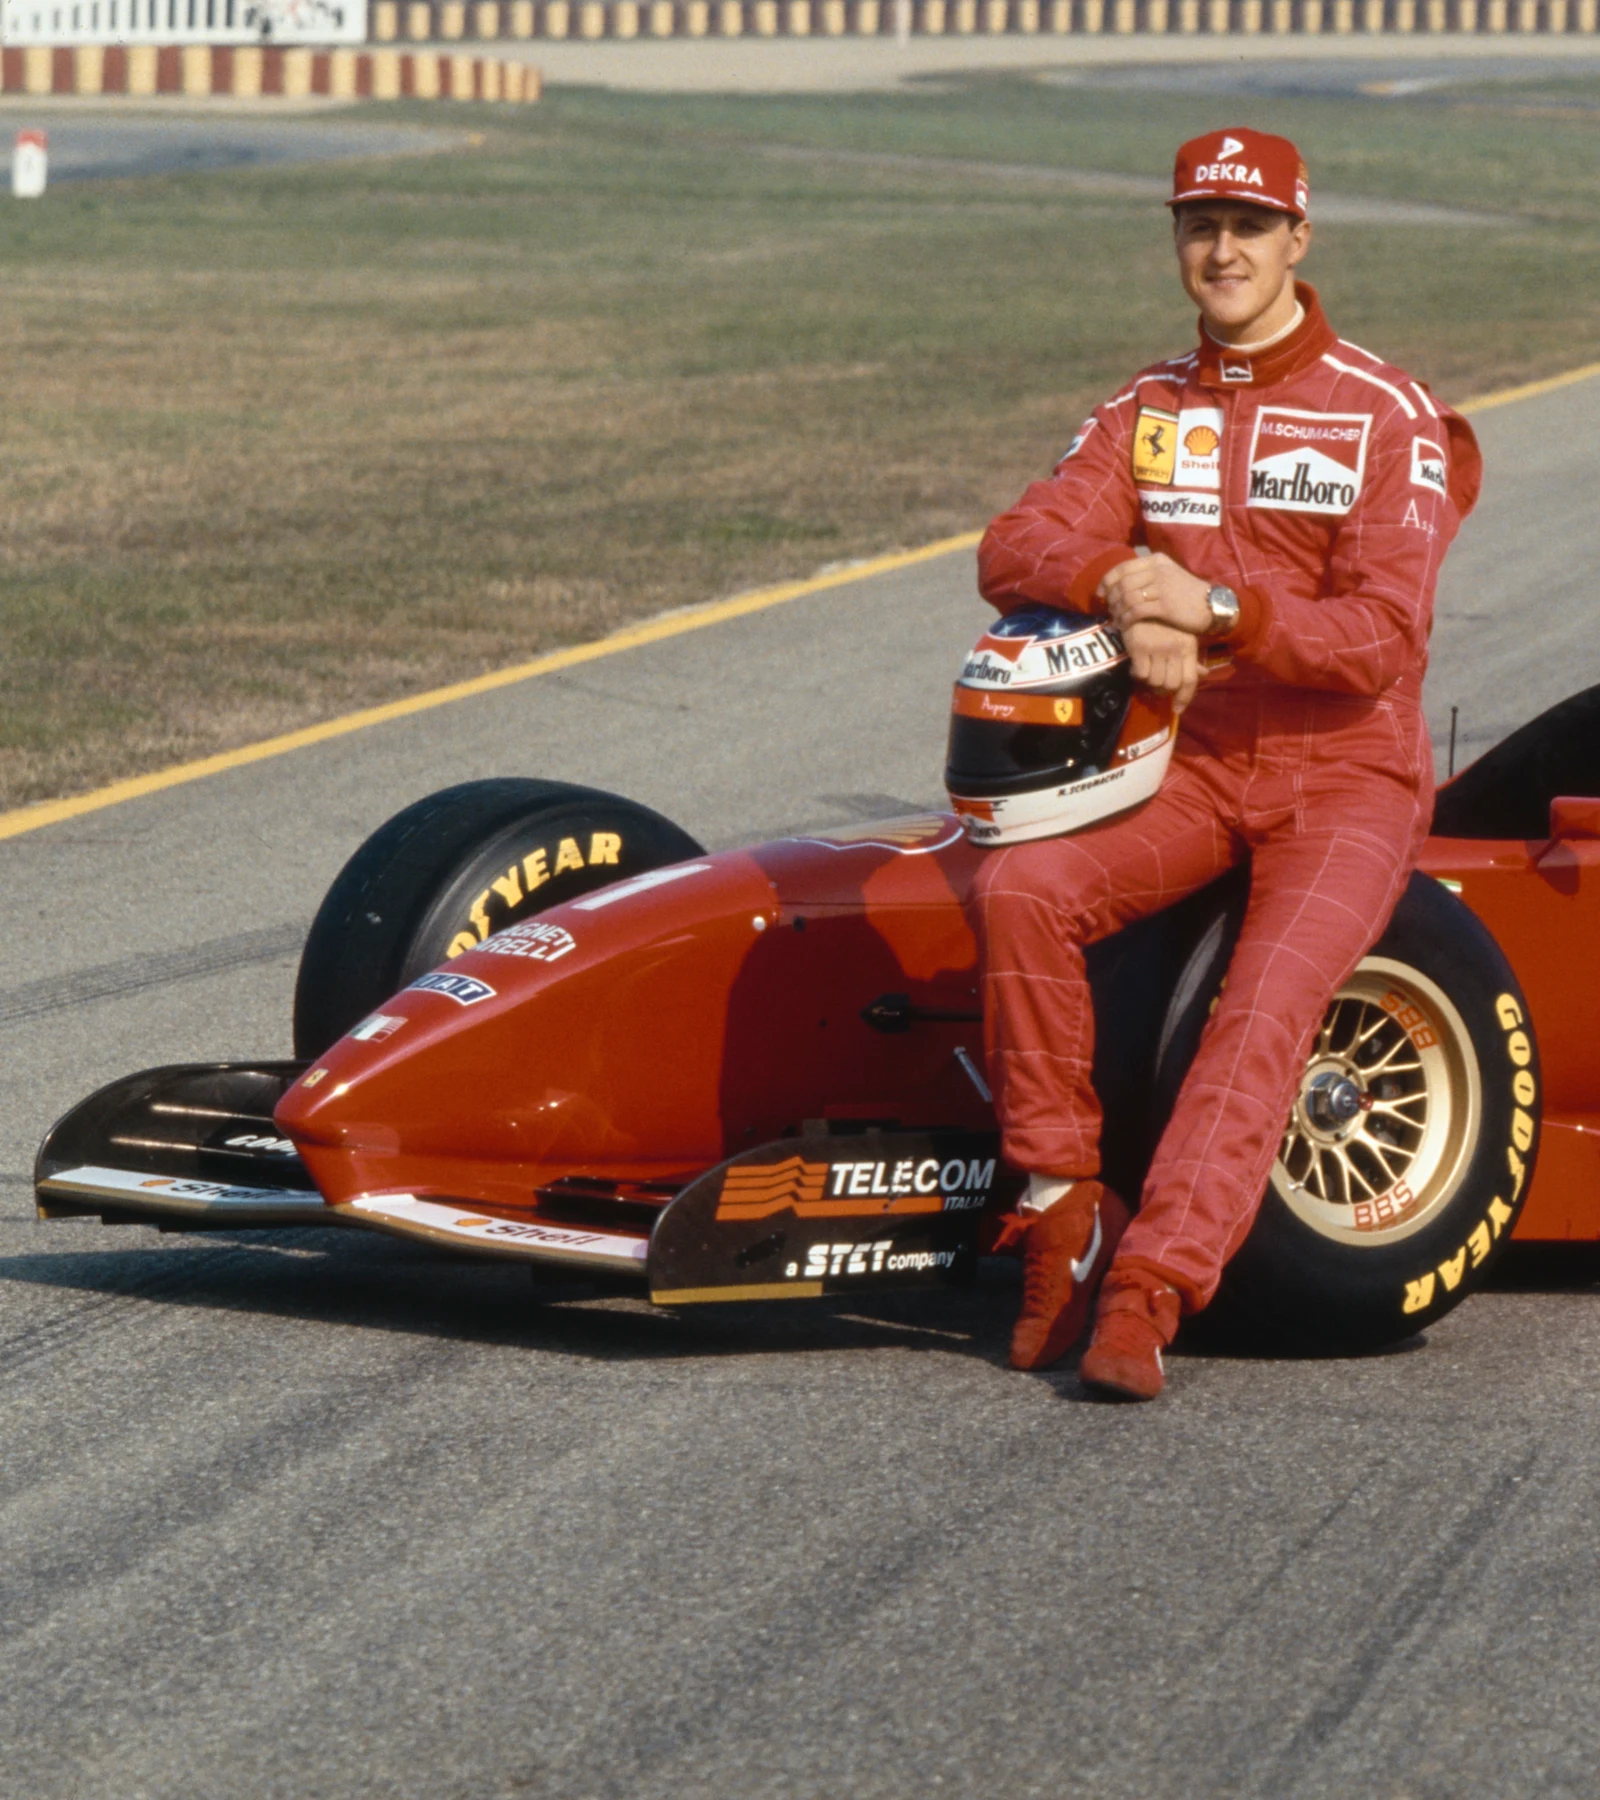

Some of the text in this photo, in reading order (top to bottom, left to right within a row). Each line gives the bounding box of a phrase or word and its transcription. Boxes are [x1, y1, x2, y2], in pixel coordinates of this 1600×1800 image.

[1195, 163, 1264, 187] DEKRA
[1250, 462, 1355, 507] Marlboro
[1380, 989, 1439, 1050] BBS
[170, 1183, 283, 1200] Shell
[831, 1158, 997, 1196] TELECOM
[943, 1195, 987, 1211] ITALIA
[1353, 1179, 1414, 1233] BBS
[485, 1224, 605, 1246] Shell
[785, 1240, 956, 1277] a STET company
